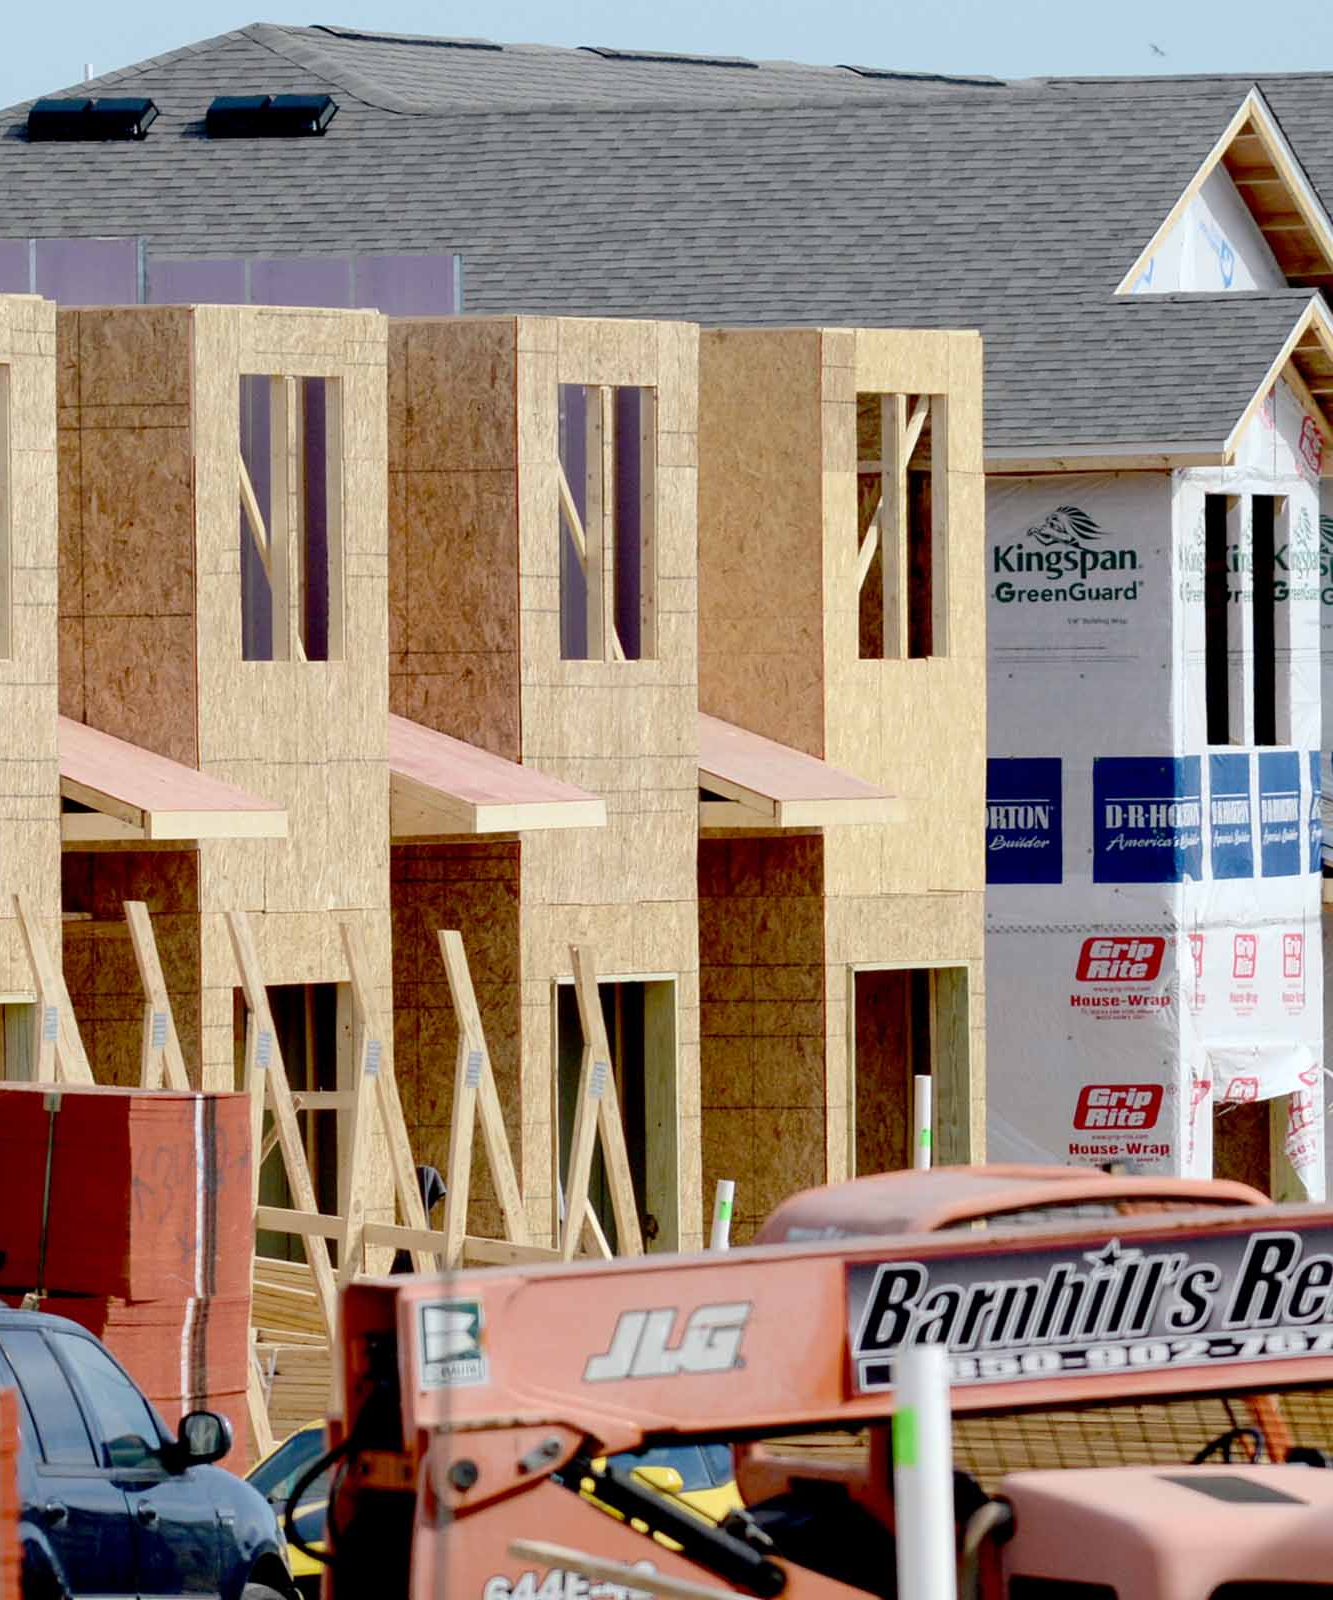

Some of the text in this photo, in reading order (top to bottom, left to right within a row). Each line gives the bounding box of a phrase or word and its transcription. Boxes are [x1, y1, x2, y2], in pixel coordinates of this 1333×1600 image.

[994, 543, 1138, 580] Kingspan
[994, 580, 1139, 603] GreenGuard
[989, 835, 1050, 851] Builder
[1089, 940, 1155, 961] Grip
[1086, 960, 1149, 979] Rite
[1069, 994, 1172, 1008] House-Wrap
[1086, 1087, 1154, 1109] Grip
[1084, 1108, 1147, 1127] Rite
[1068, 1142, 1170, 1156] House-Wrap
[849, 1246, 1222, 1356] Barnhill's
[583, 1301, 753, 1382] JLG
